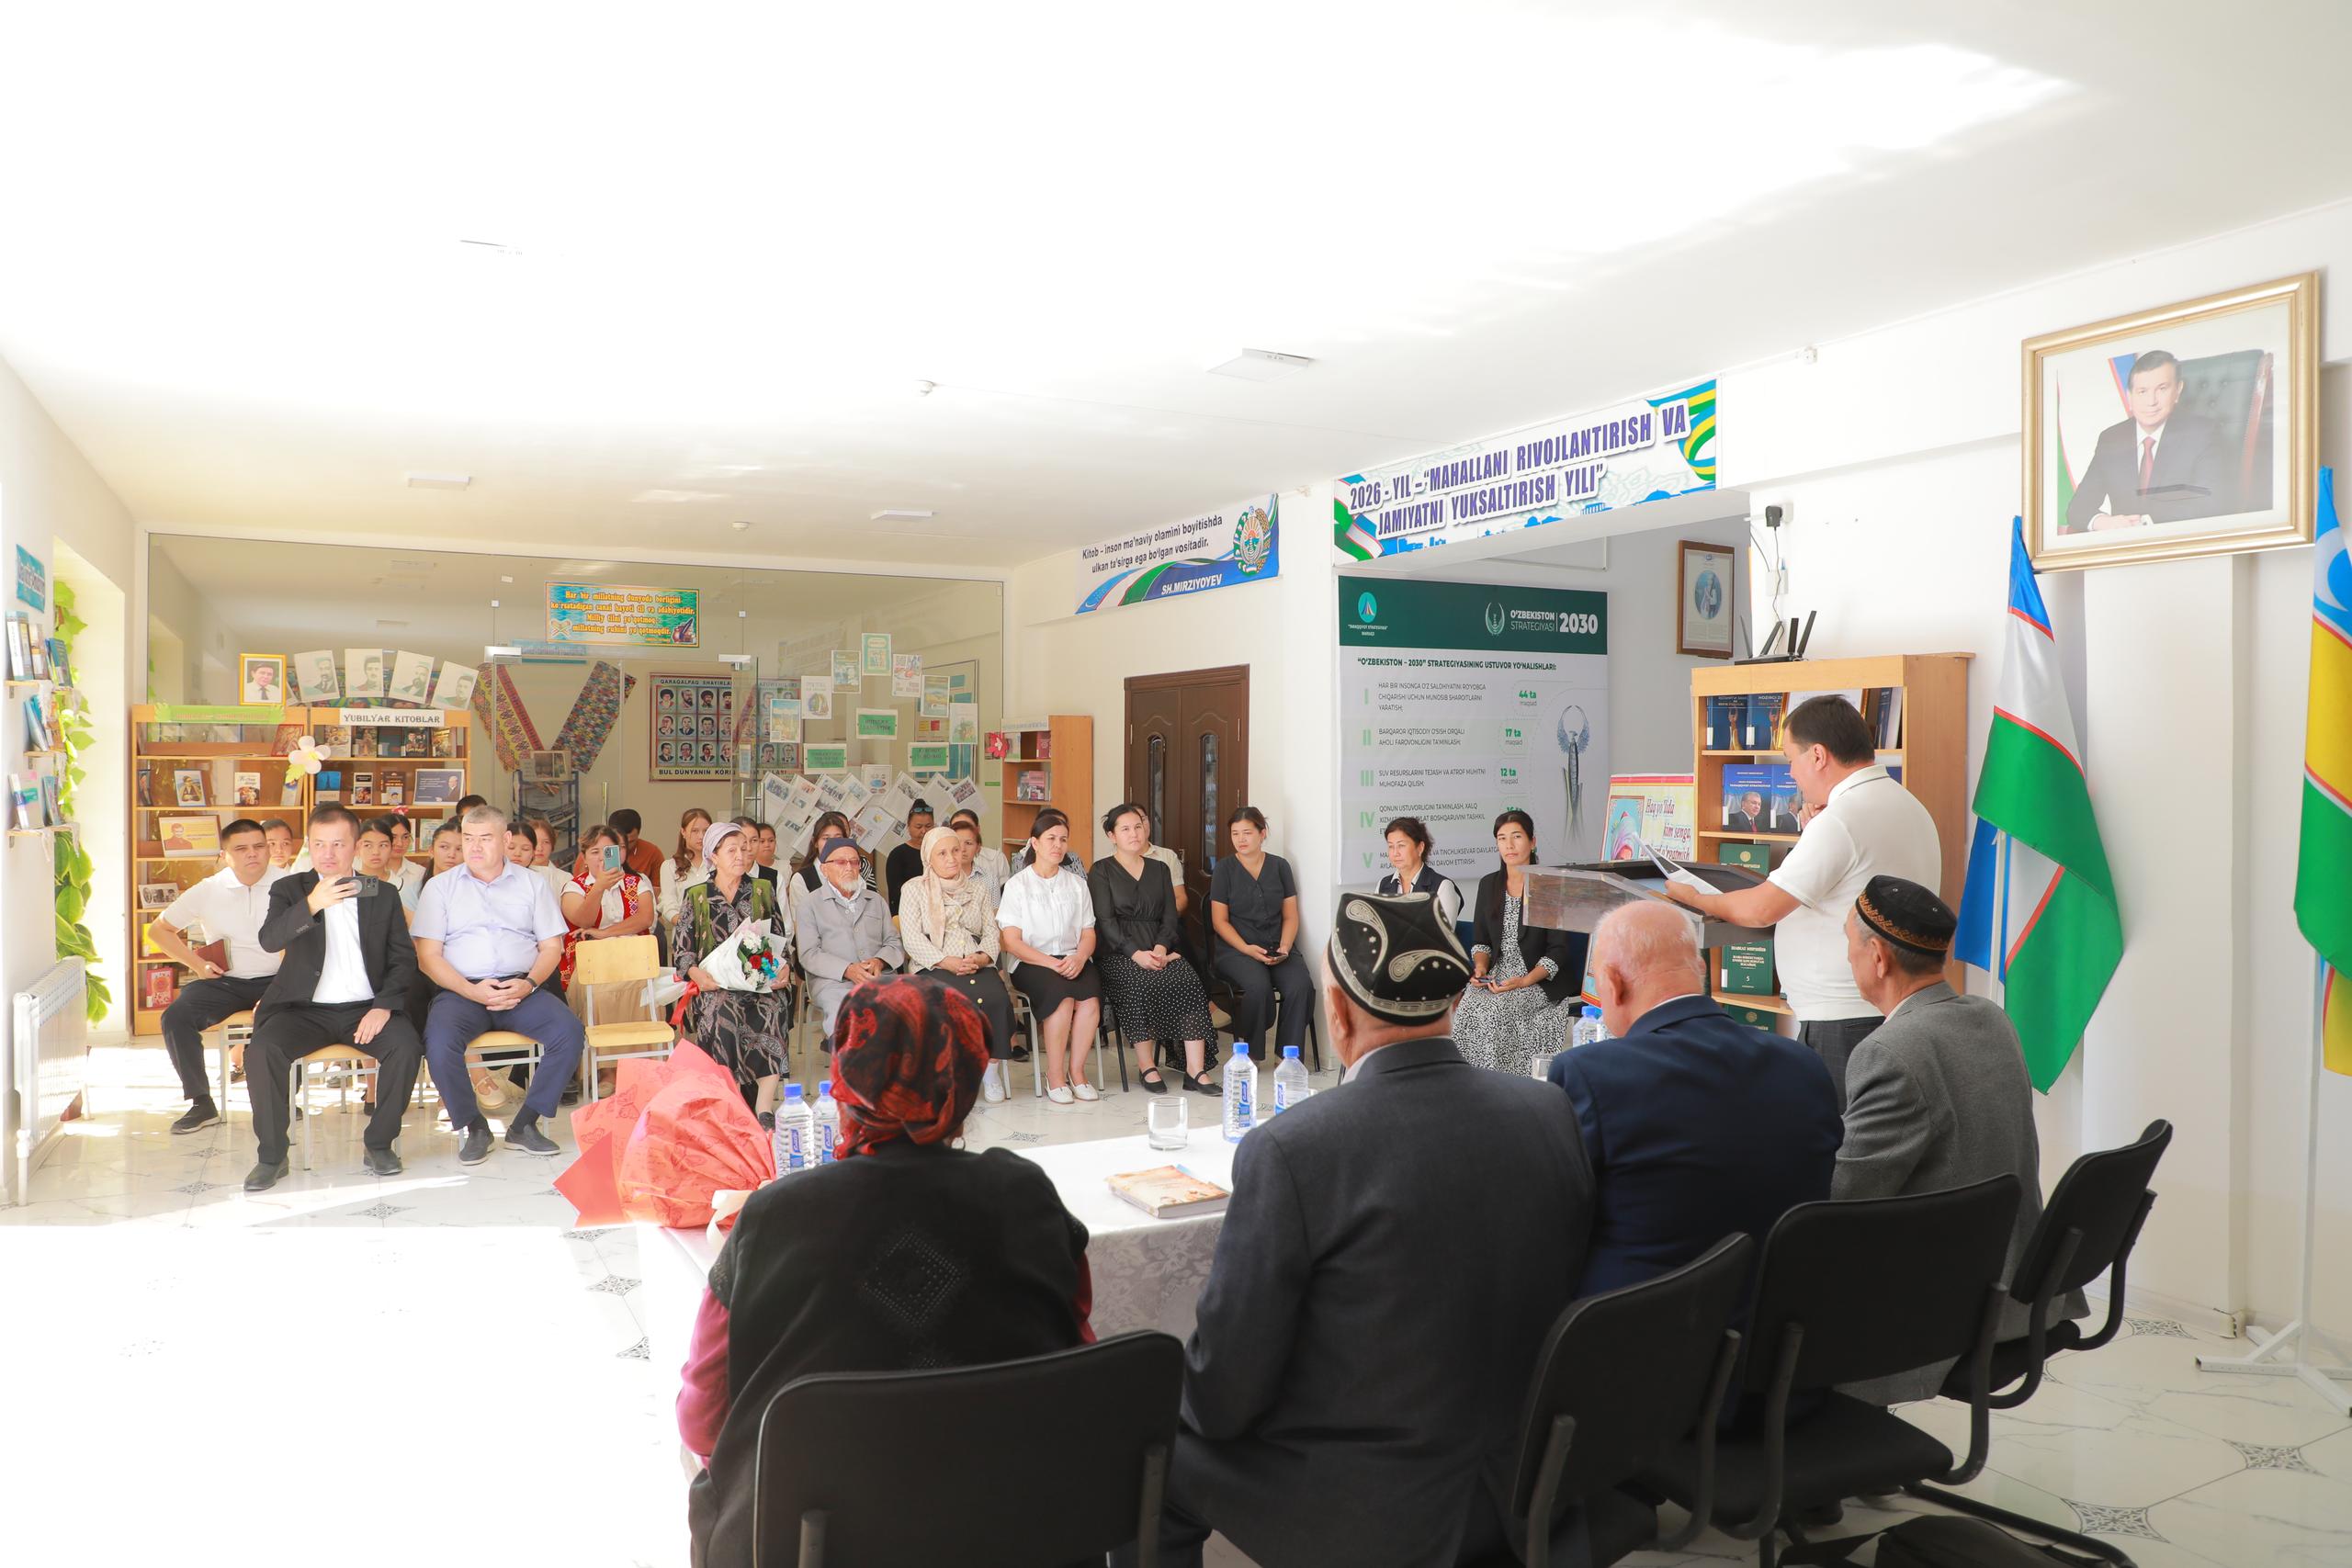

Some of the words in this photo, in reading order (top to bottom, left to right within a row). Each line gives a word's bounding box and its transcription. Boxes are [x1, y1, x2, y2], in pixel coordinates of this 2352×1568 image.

[1351, 482, 1381, 511] 2026
[1393, 475, 1411, 501] YIL
[1517, 413, 1652, 471] RIVOJLANTIRISH
[1662, 404, 1686, 436] VA
[1378, 500, 1443, 536] JAMIYATNI
[1452, 474, 1555, 520] YUKSALTIRISH
[1082, 547, 1099, 560] Kitob
[1104, 542, 1122, 554] inson
[1154, 525, 1181, 542] olamini
[1182, 515, 1223, 537] boyitishda
[1091, 560, 1109, 573] ulkan
[1135, 553, 1148, 565] ega
[1174, 536, 1209, 554] vositadir.
[1161, 573, 1222, 595] SH.MIRZIYOYEV
[1510, 621, 1555, 631] STRATEGIYASI
[1559, 612, 1599, 635] 2030
[1427, 660, 1484, 668] STRATEGIYASINING
[1485, 660, 1512, 669] USTUVOR
[1530, 691, 1537, 699] ta
[344, 714, 390, 723] YUBILYAR
[1506, 728, 1512, 737] 17
[1514, 728, 1521, 738] ta
[1500, 768, 1508, 776] 12
[1510, 768, 1516, 776] ta
[1379, 805, 1398, 813] QONUN
[1361, 812, 1375, 827] IV
[1363, 852, 1373, 868] V
